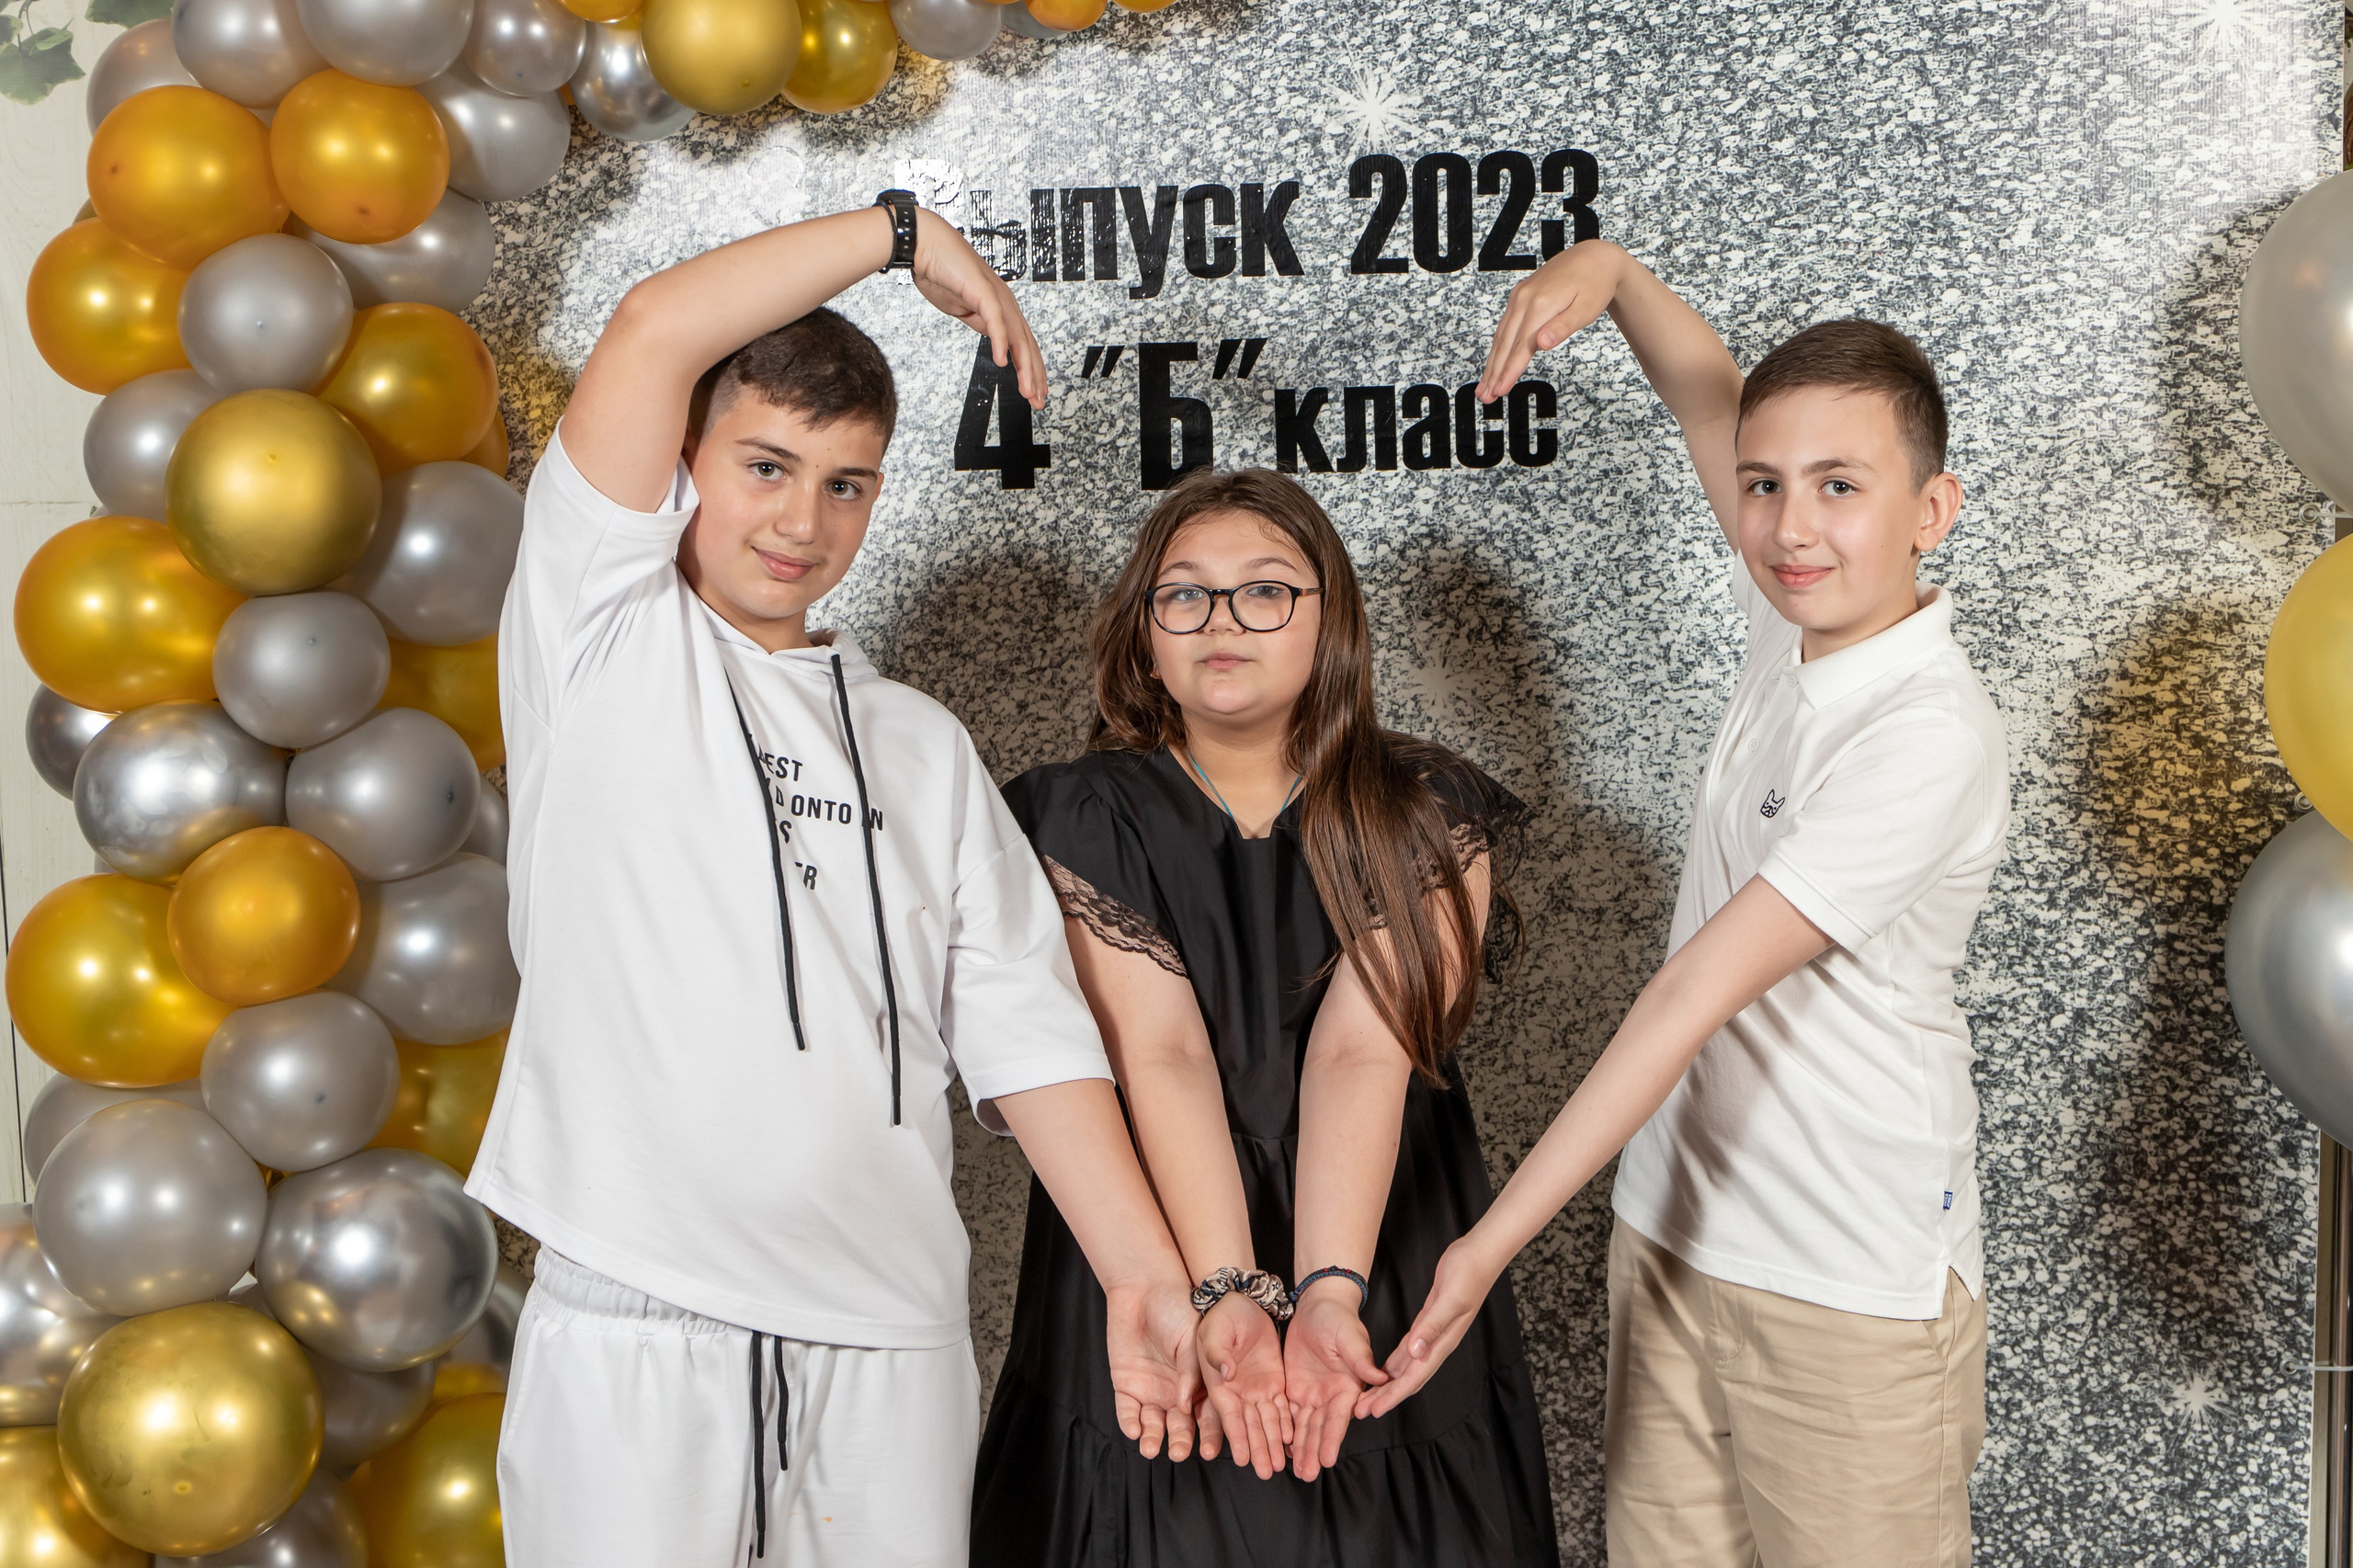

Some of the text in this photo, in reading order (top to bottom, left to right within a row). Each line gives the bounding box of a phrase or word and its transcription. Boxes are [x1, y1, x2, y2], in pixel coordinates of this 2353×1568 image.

[1349, 149, 1600, 274] 2023
[954, 334, 1051, 491] 4
[1275, 380, 1558, 473] класс
